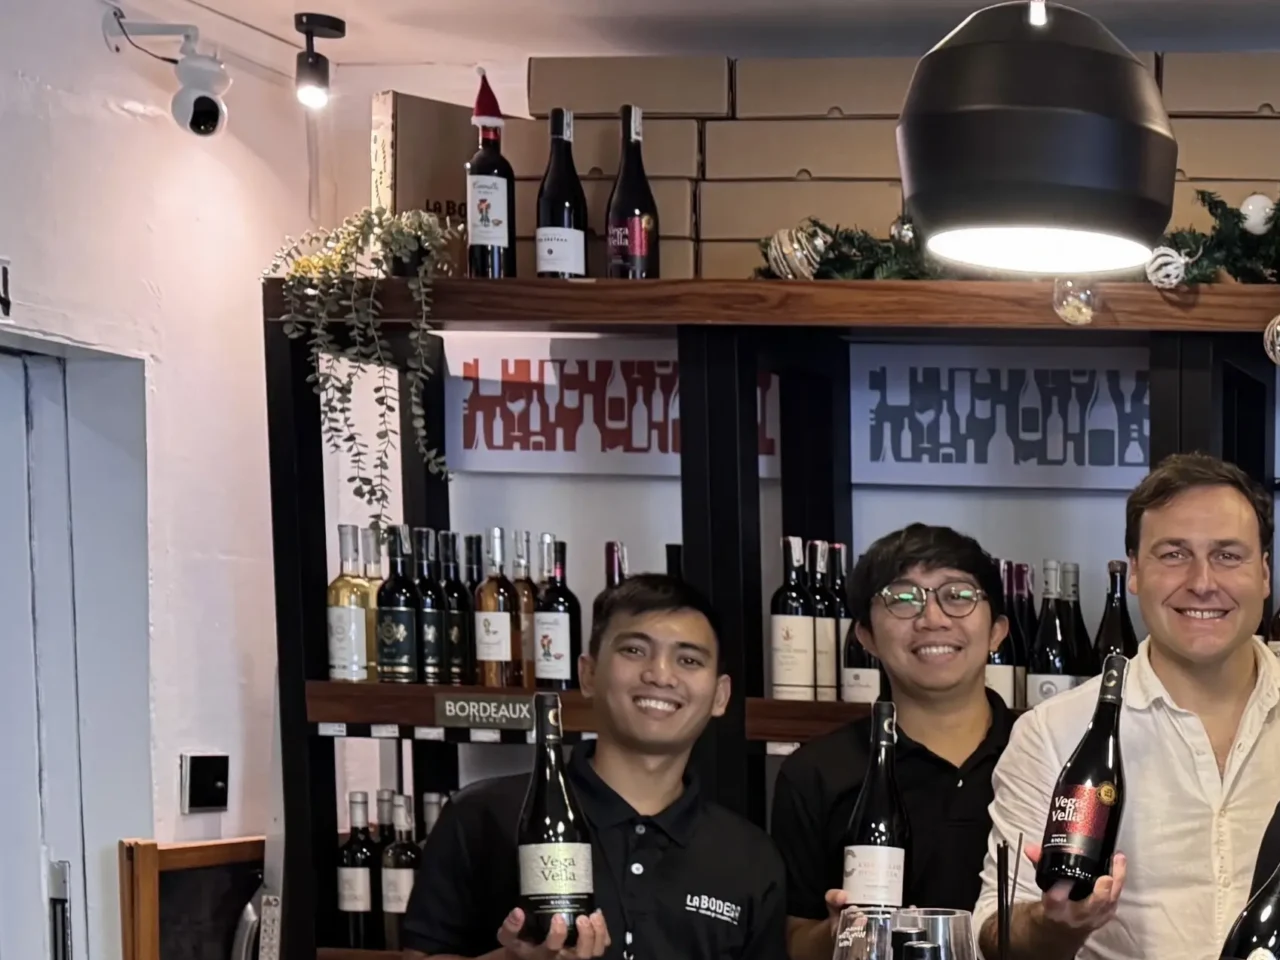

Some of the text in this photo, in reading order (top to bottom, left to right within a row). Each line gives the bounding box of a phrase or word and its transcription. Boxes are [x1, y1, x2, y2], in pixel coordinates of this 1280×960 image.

[445, 701, 531, 719] BORDEAUX
[540, 855, 576, 869] Vega
[541, 869, 577, 881] Vella
[686, 894, 699, 907] LA
